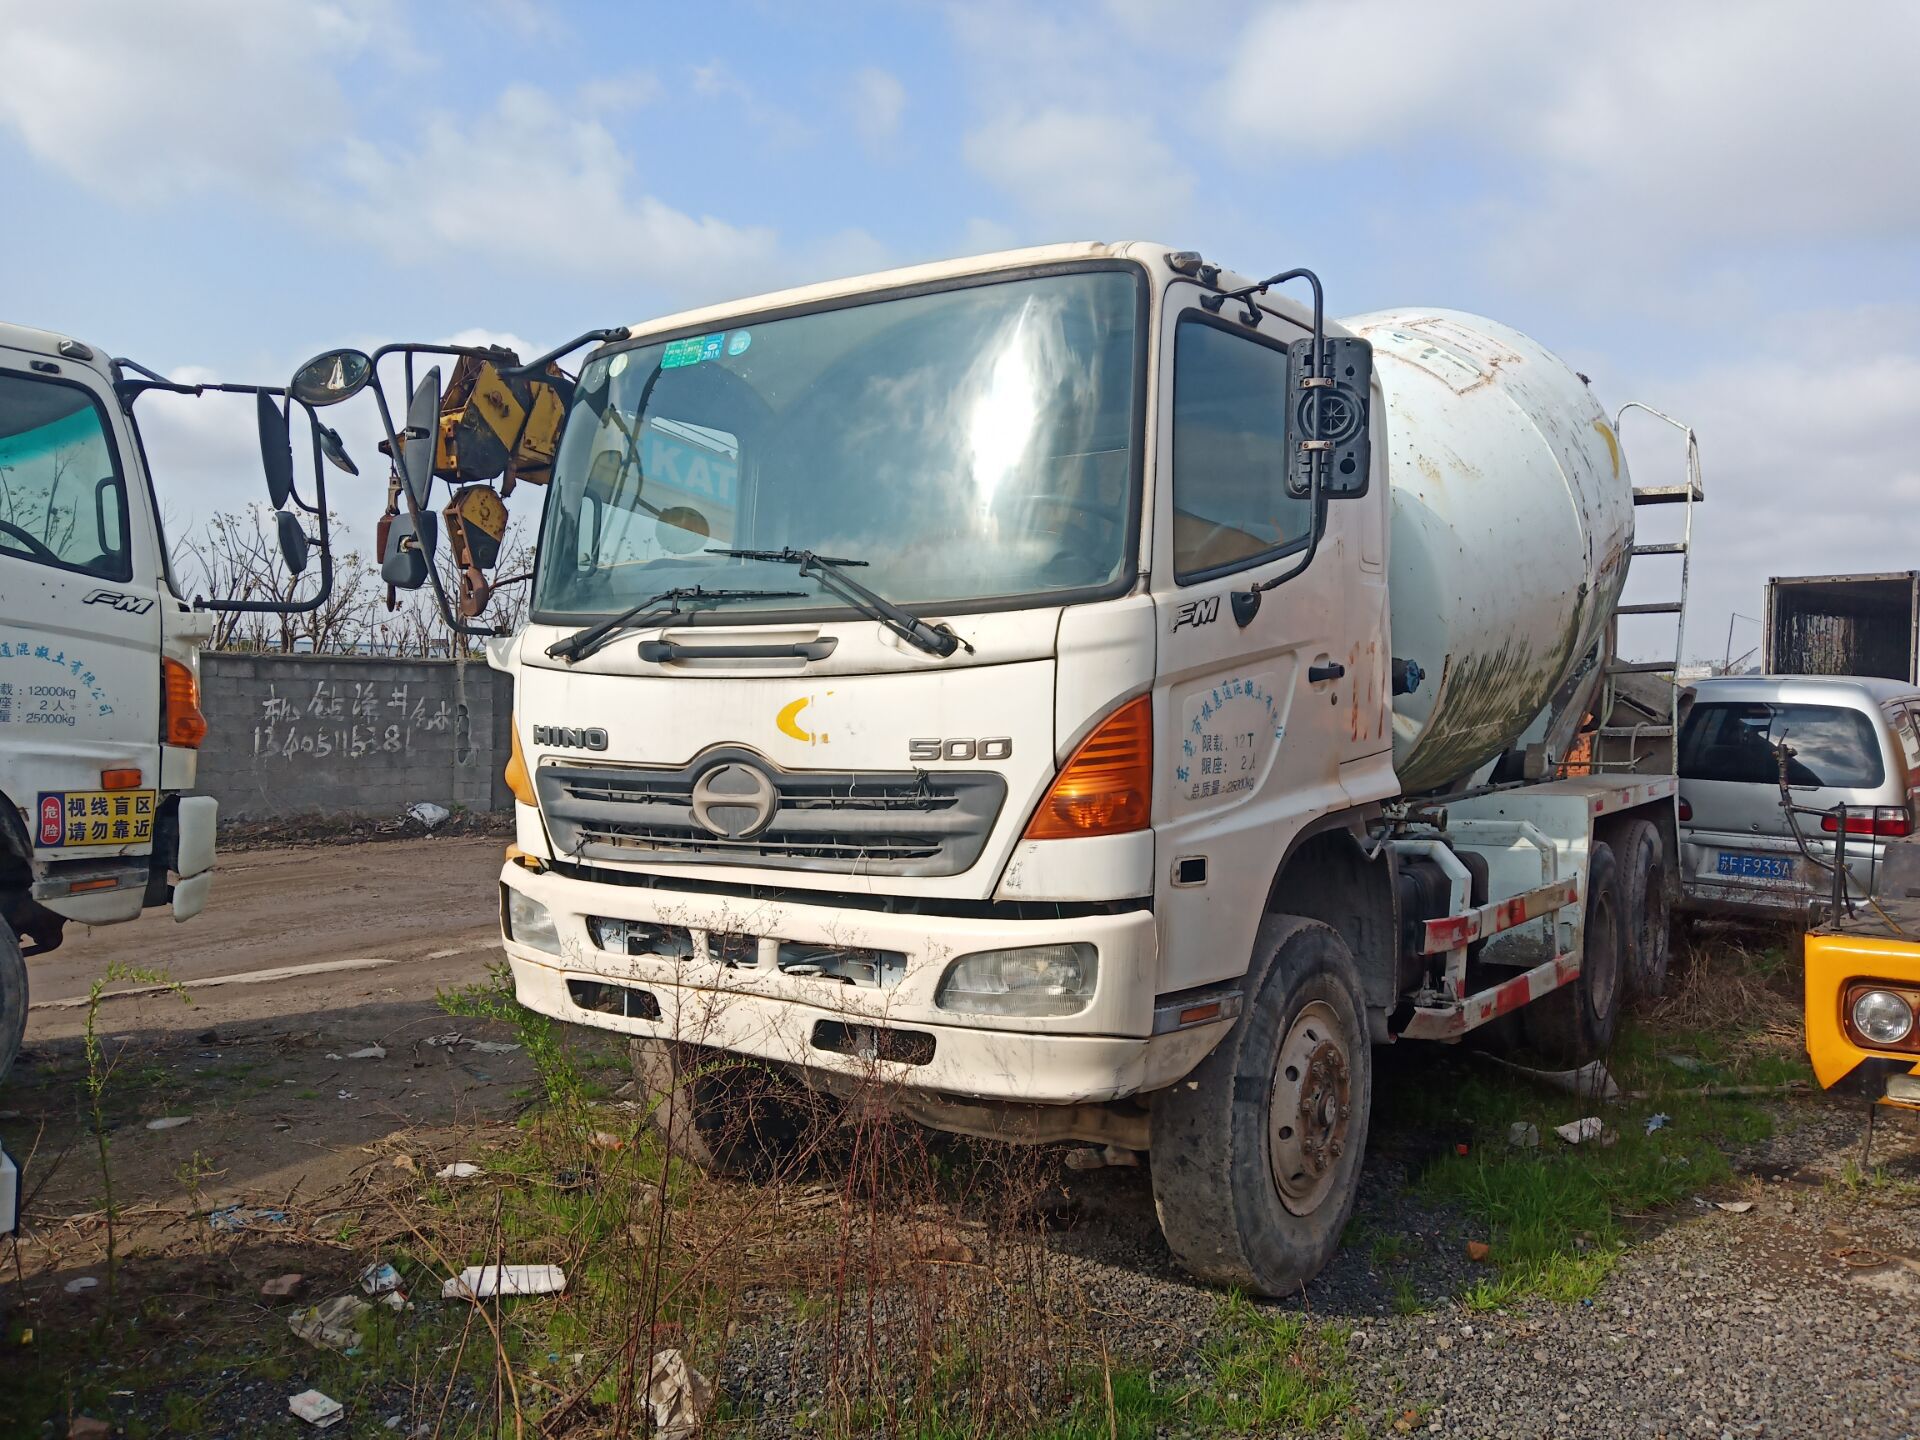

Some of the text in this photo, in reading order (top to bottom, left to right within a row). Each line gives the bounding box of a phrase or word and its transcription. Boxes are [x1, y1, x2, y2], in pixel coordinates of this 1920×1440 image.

[82, 588, 155, 615] FM
[1172, 596, 1220, 634] FM
[533, 724, 609, 751] HINO
[909, 736, 1012, 761] 500
[68, 796, 151, 817] 视线盲区
[44, 805, 59, 837] 危险
[68, 820, 150, 841] 请勿靠近
